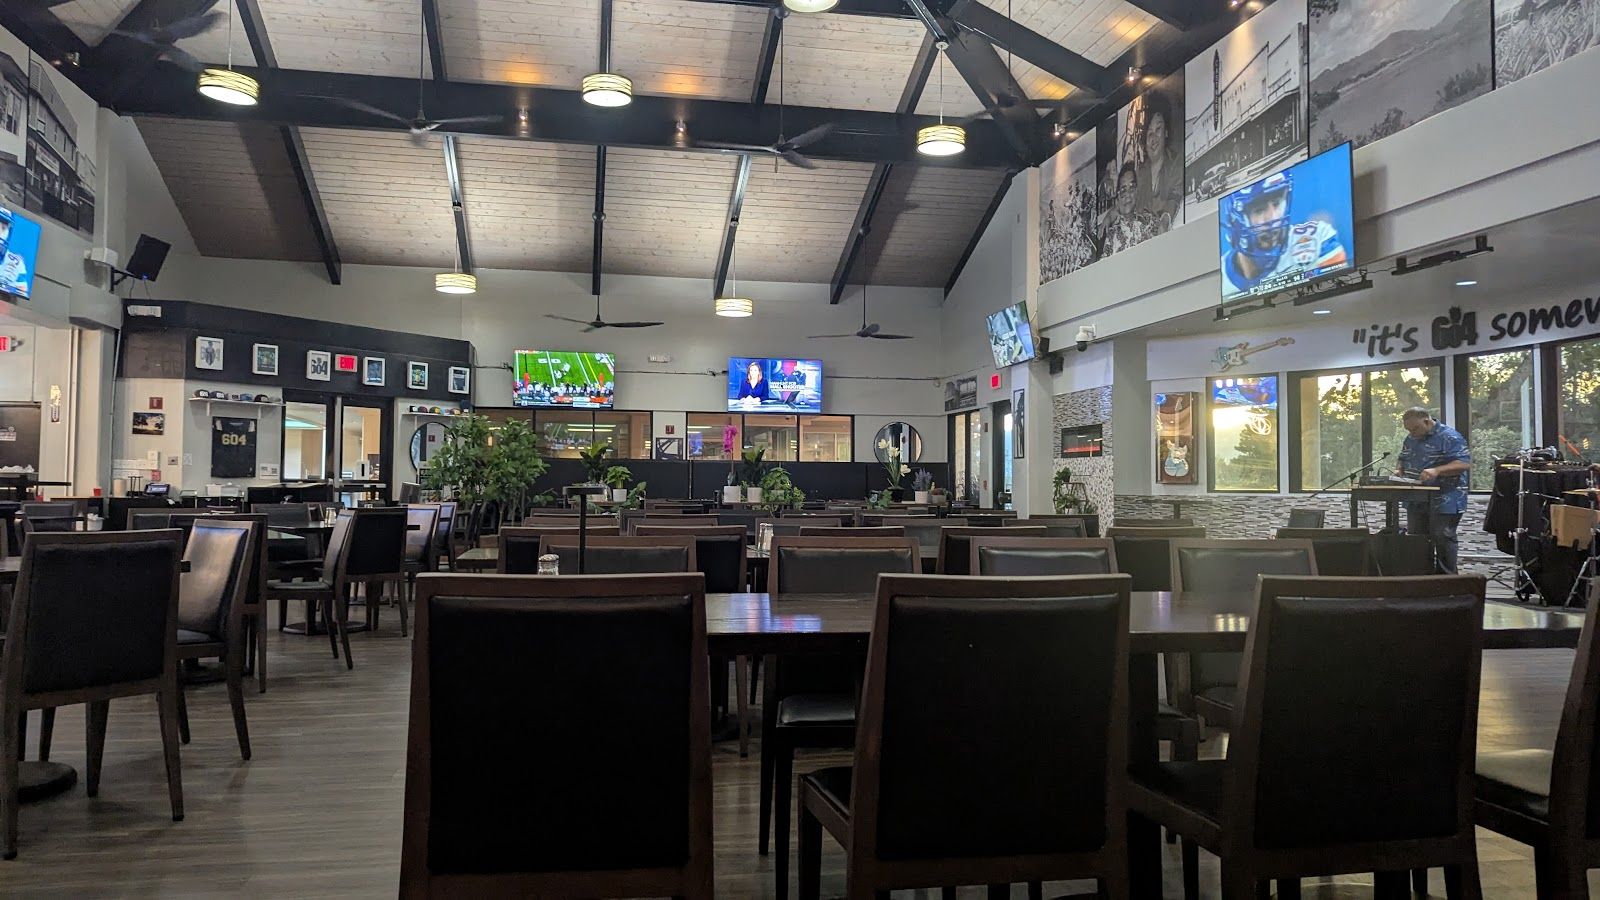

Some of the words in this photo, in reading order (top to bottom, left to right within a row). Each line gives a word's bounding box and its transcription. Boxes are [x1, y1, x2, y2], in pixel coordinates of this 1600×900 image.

[1353, 322, 1418, 358] "it's
[311, 359, 328, 375] 604
[340, 356, 354, 370] EXIT
[222, 433, 247, 446] 604
